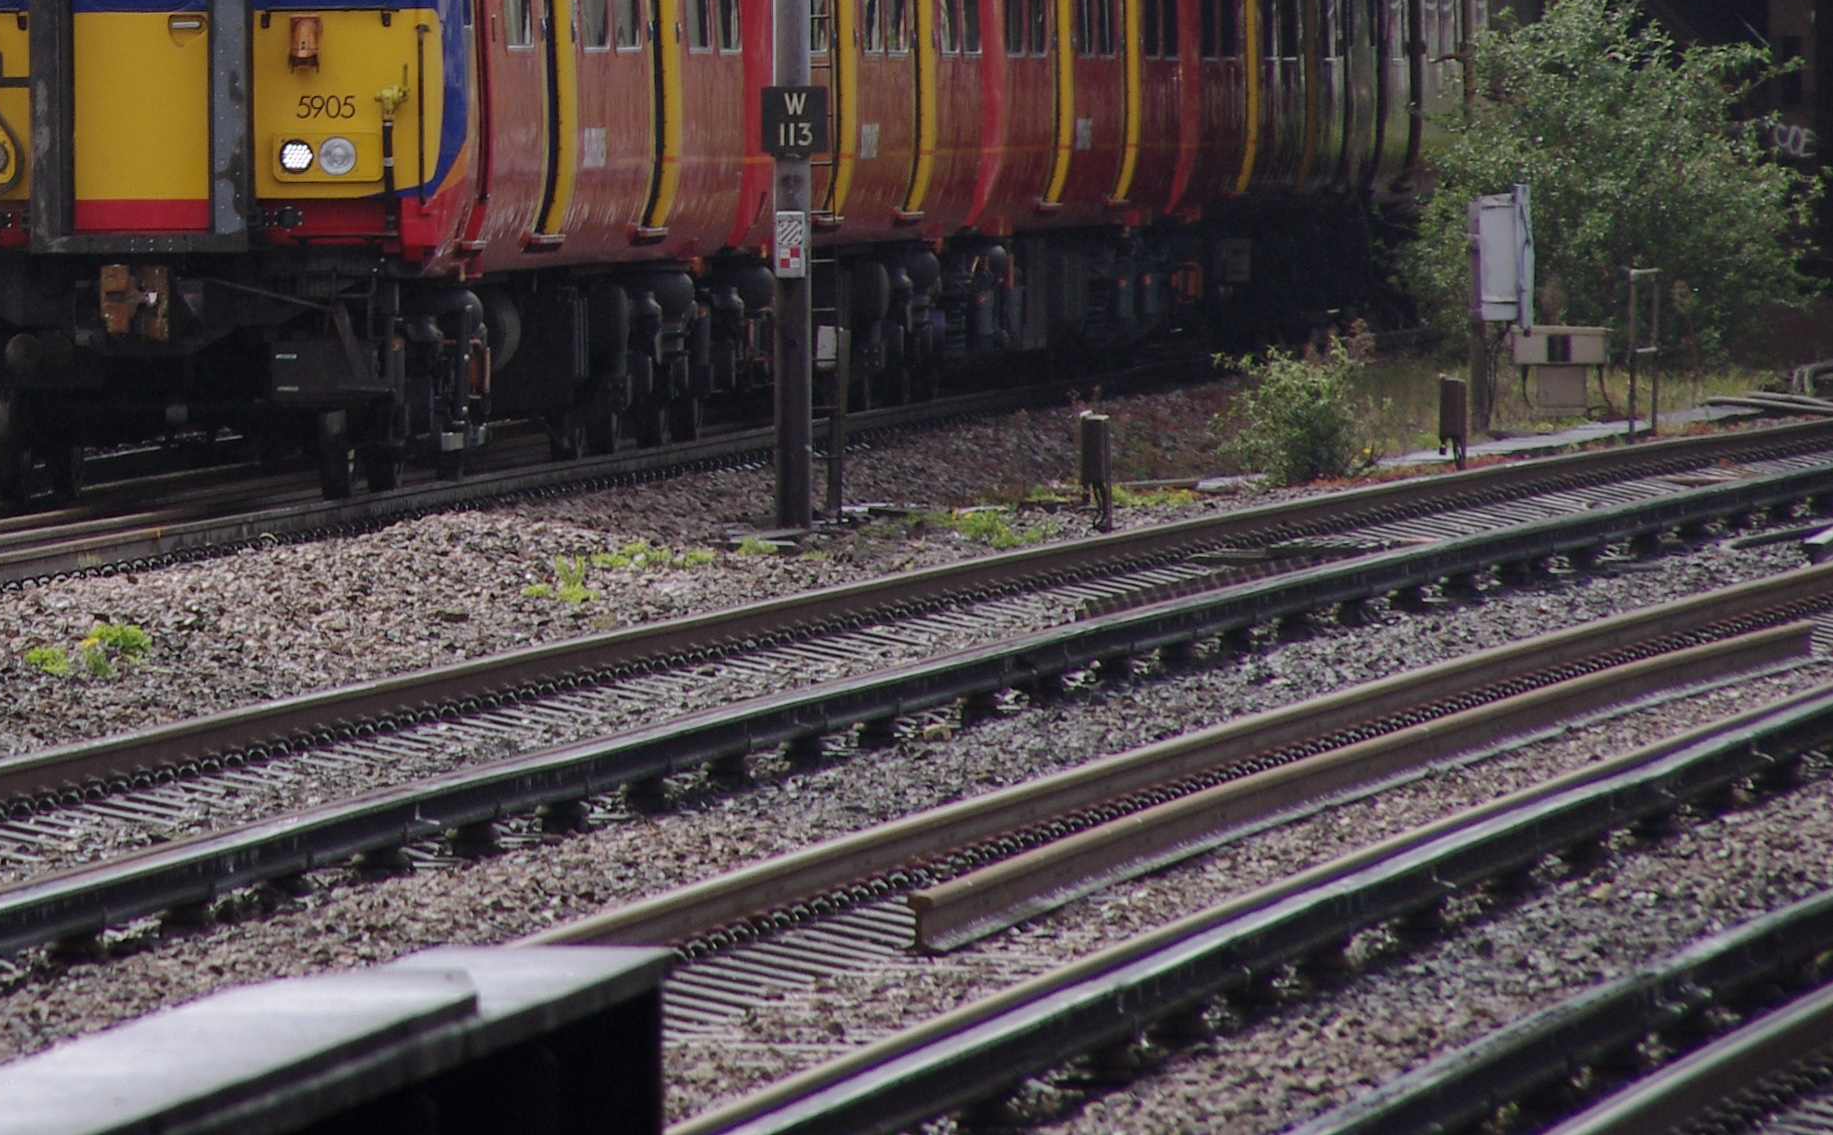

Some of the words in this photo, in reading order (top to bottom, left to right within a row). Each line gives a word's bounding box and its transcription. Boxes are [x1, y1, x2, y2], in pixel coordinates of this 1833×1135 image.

[296, 95, 356, 119] 5905
[784, 92, 807, 115] W
[779, 122, 813, 146] 113
